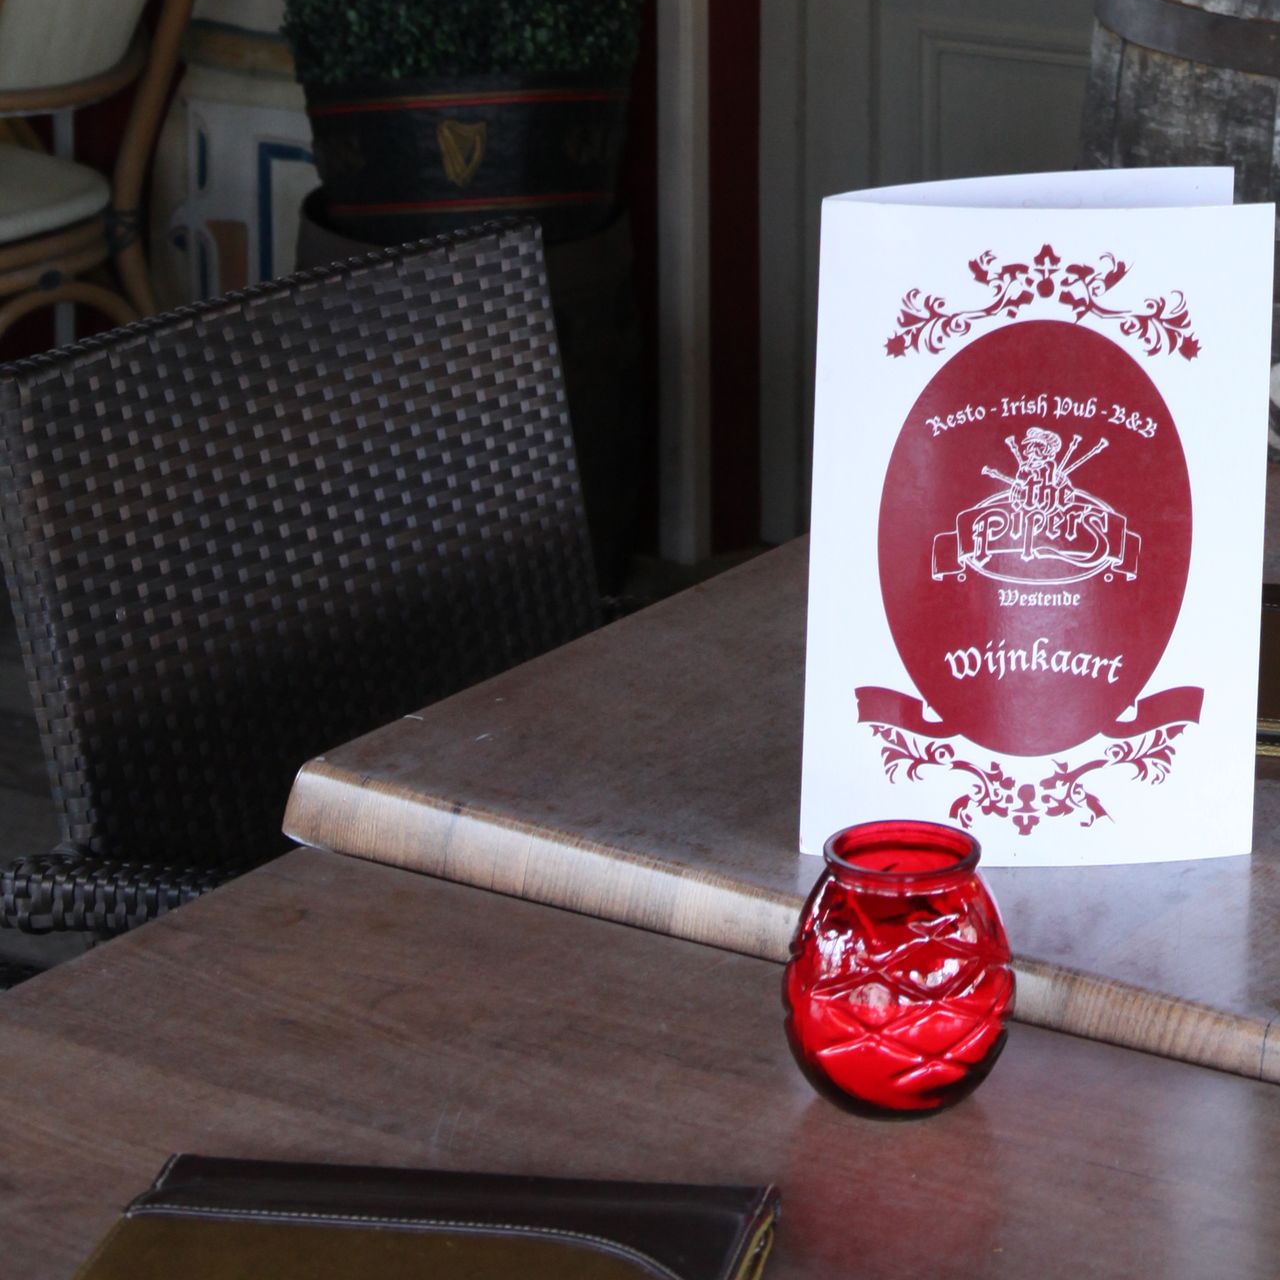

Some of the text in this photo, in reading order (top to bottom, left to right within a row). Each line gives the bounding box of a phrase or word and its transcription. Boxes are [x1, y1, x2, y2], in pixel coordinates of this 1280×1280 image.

[925, 403, 986, 437] Resto
[1000, 393, 1048, 418] Irish
[1053, 396, 1098, 420] Pub
[1107, 404, 1159, 439] B&B
[998, 589, 1081, 607] Westende
